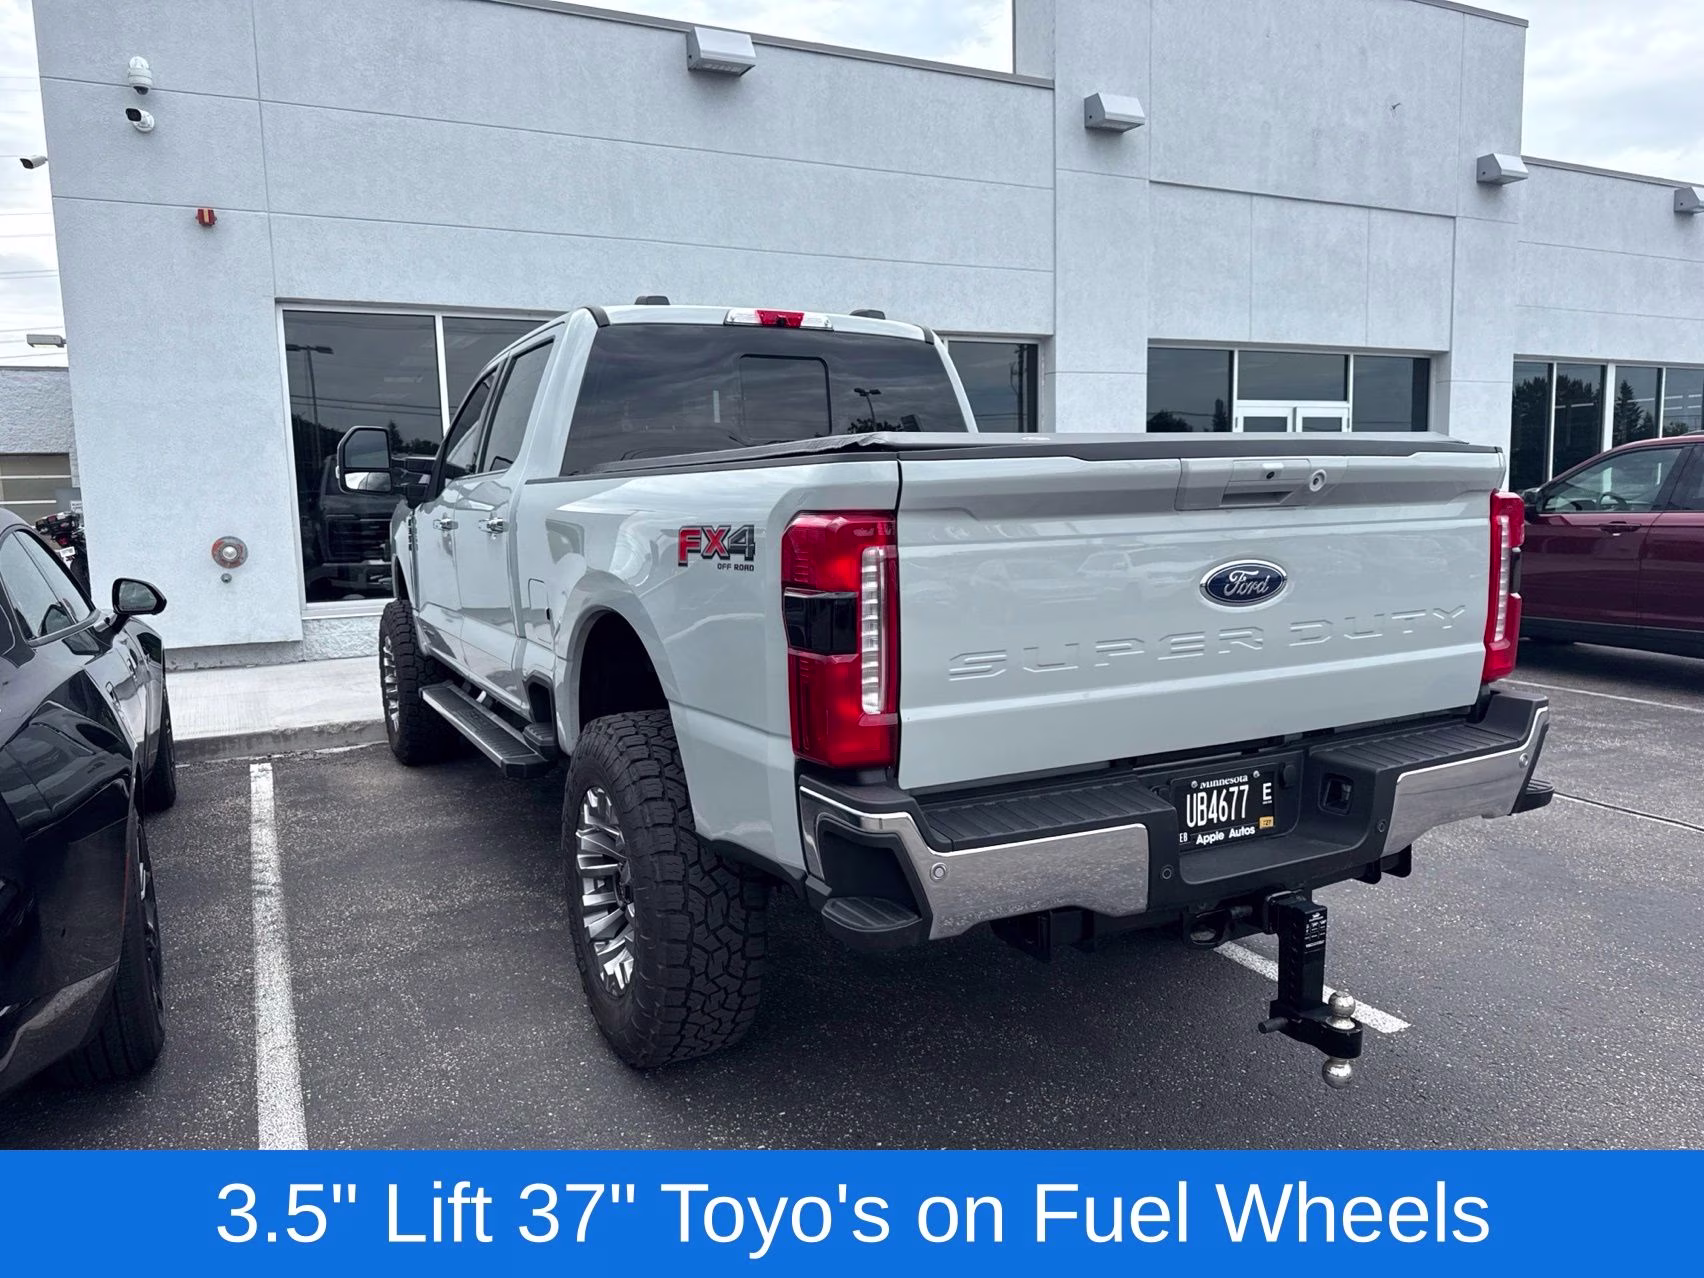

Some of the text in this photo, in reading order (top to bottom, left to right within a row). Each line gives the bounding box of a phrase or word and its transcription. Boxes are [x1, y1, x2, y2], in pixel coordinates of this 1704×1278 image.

[678, 525, 755, 567] FX4
[1224, 570, 1270, 596] Ford
[949, 605, 1466, 681] SUPER DUTY
[1200, 775, 1248, 789] Minnesota
[1263, 782, 1272, 800] E
[1186, 785, 1249, 828] UB4677
[1195, 826, 1256, 845] Apple Autos
